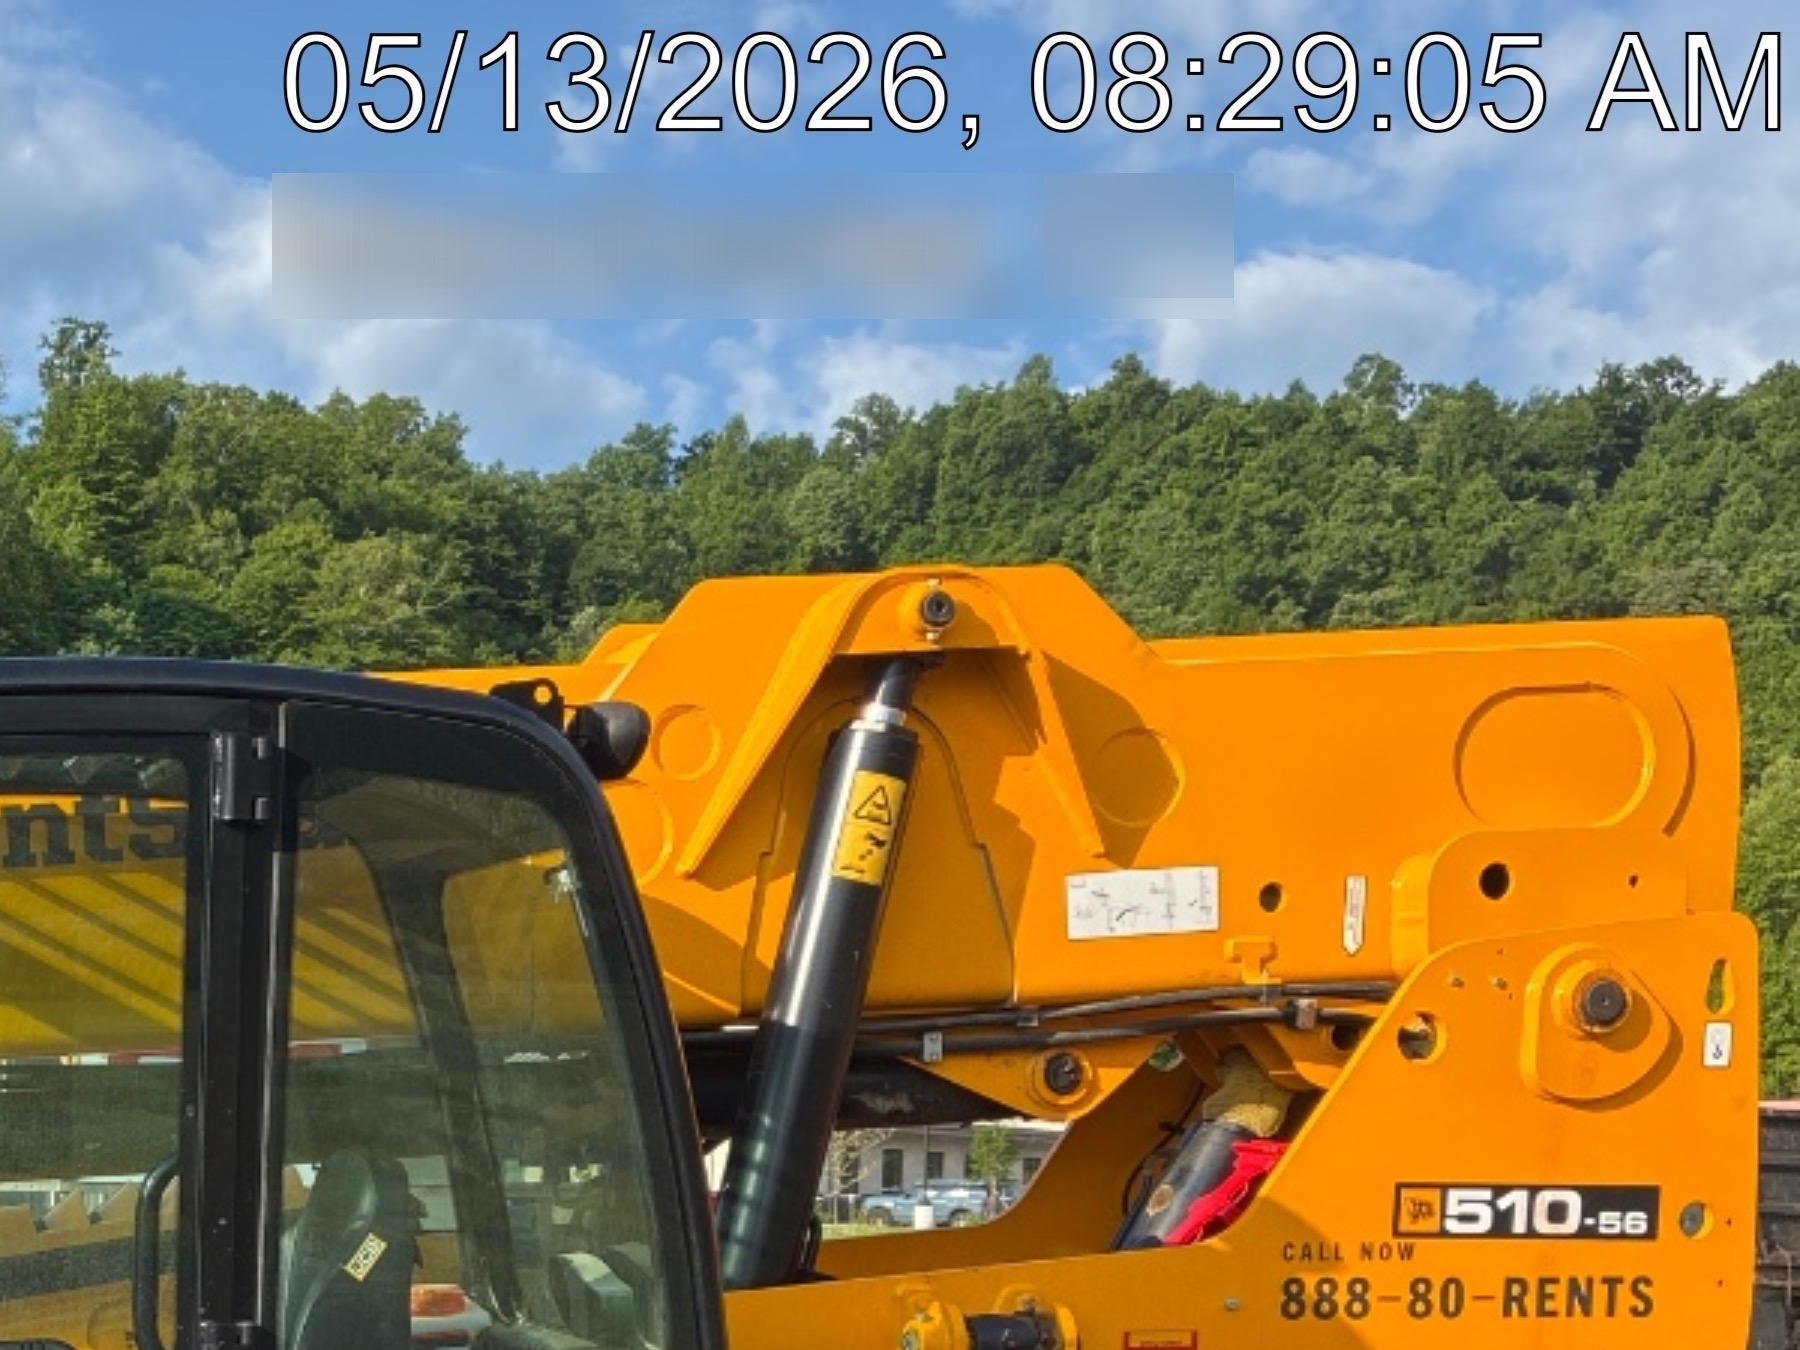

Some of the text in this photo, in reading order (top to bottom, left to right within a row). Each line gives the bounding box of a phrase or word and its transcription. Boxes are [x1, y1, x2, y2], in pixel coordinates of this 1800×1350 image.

[1443, 1188, 1649, 1235] 510-56
[1282, 1240, 1416, 1262] CALL NOW
[1279, 1274, 1655, 1322] 888-80-RENTS
